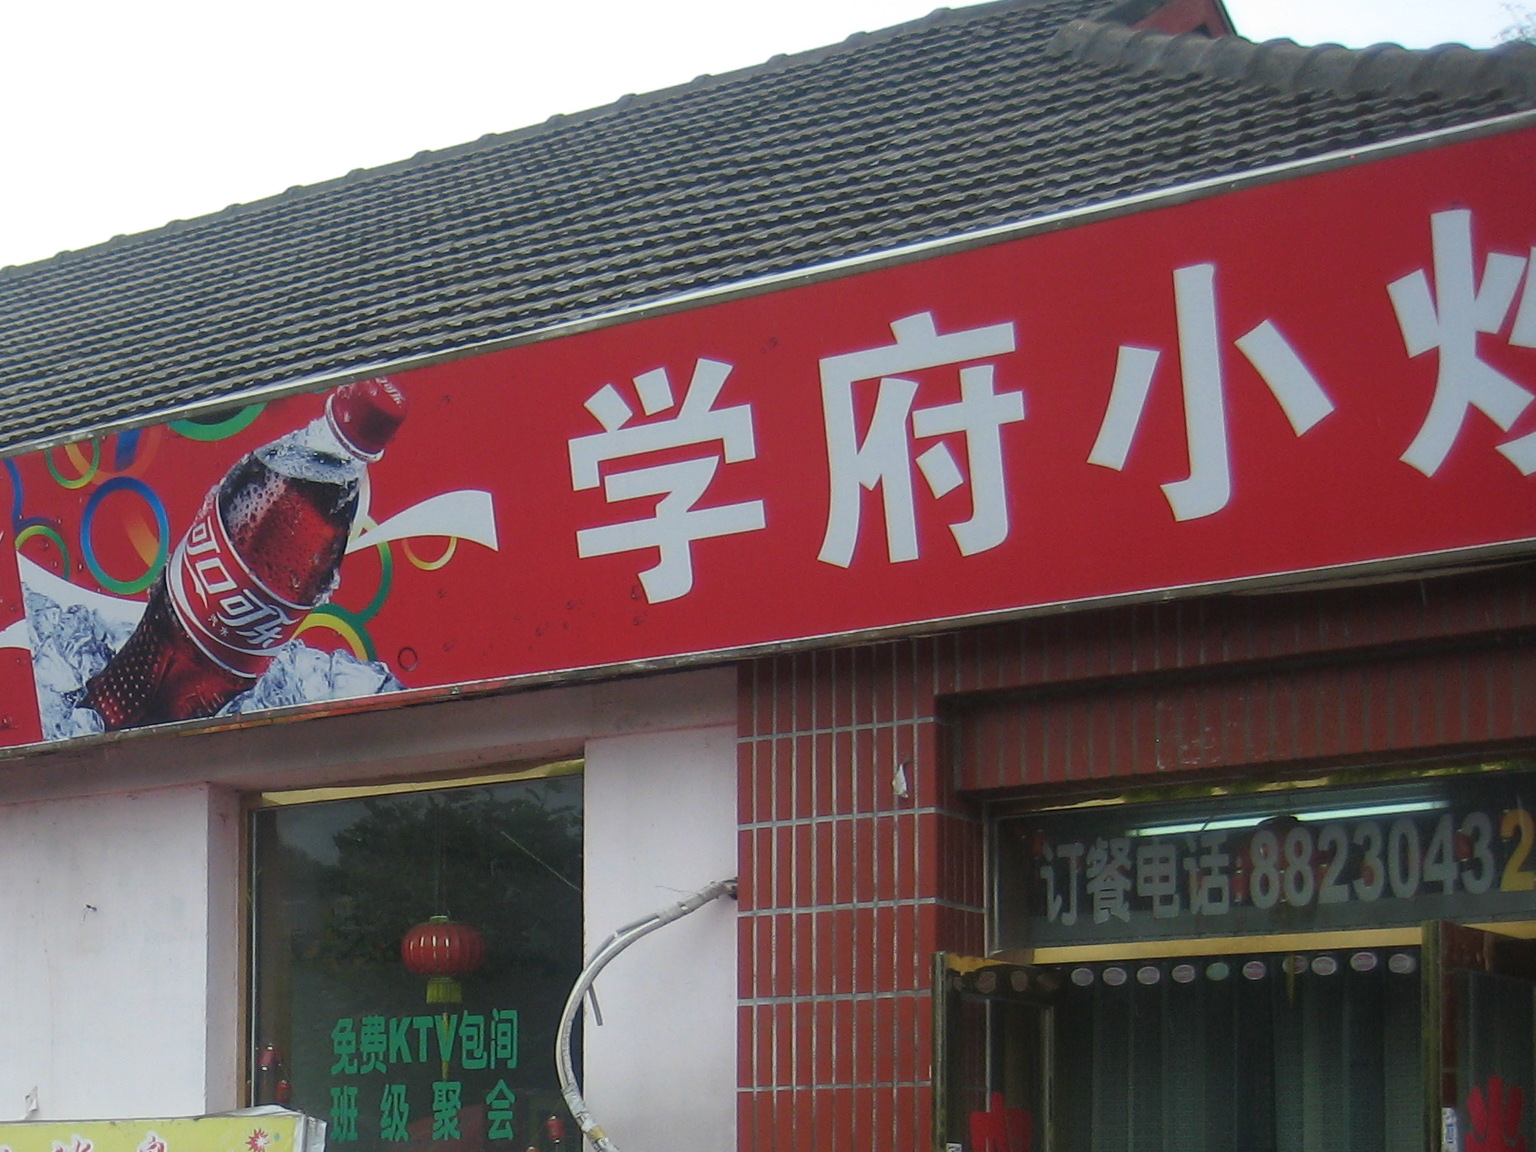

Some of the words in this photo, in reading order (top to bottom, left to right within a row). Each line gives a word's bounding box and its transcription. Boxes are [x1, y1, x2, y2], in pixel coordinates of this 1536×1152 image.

[568, 208, 1536, 605] 学府小炒
[185, 516, 304, 648] 可口可乐
[331, 1009, 519, 1075] 免费KTV包间
[330, 1079, 516, 1143] 班级聚会
